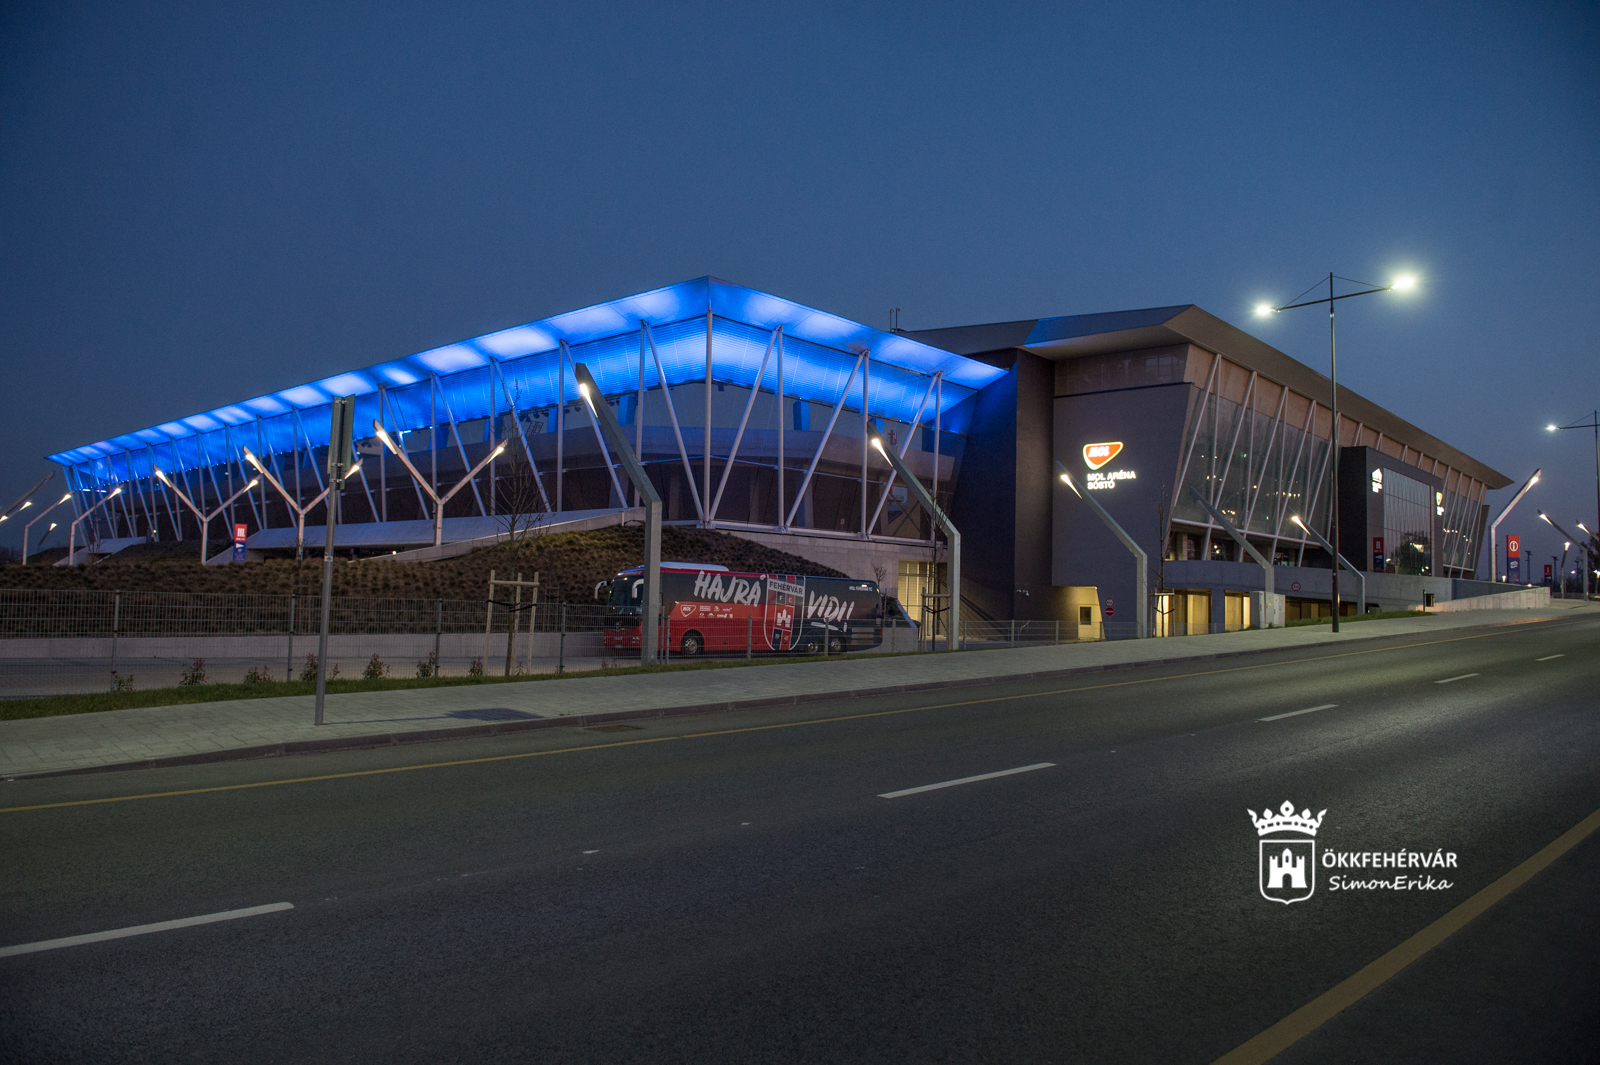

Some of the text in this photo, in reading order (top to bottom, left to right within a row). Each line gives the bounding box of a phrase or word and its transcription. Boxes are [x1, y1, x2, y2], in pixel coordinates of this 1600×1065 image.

[1088, 446, 1110, 457] MOL
[1087, 470, 1136, 481] MOL ARÉNA
[694, 570, 766, 607] HAJRÁ
[769, 580, 803, 595] FEHÉRVÁR
